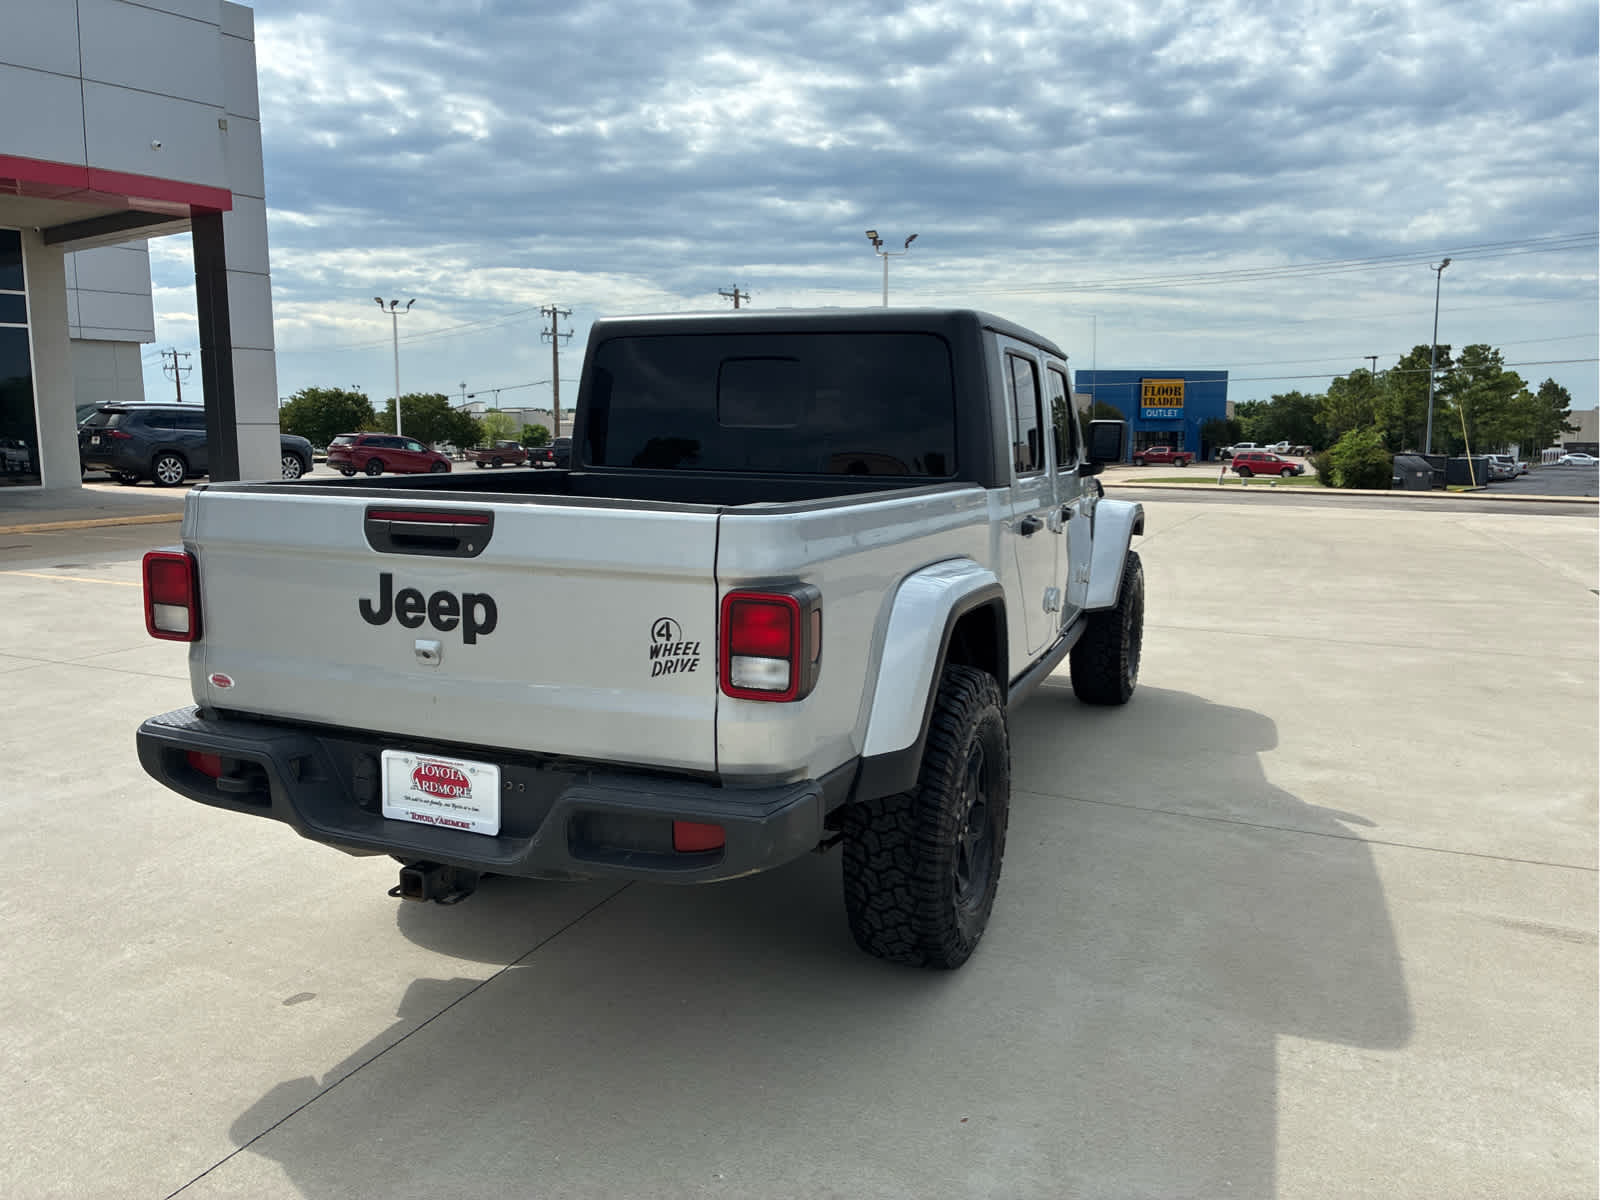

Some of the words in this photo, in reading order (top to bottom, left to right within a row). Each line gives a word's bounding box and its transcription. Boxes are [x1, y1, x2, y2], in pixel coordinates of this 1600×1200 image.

[1144, 386, 1182, 396] FLOOR
[1144, 398, 1183, 406] TRADER
[1146, 409, 1178, 417] OUTLET
[358, 573, 498, 645] Jeep
[656, 621, 672, 641] 4
[650, 642, 700, 660] WHEEL
[651, 658, 700, 678] DRIVE
[417, 762, 465, 781] TOYOTA
[410, 777, 473, 799] ARDMORE
[410, 811, 433, 823] TOYOTA
